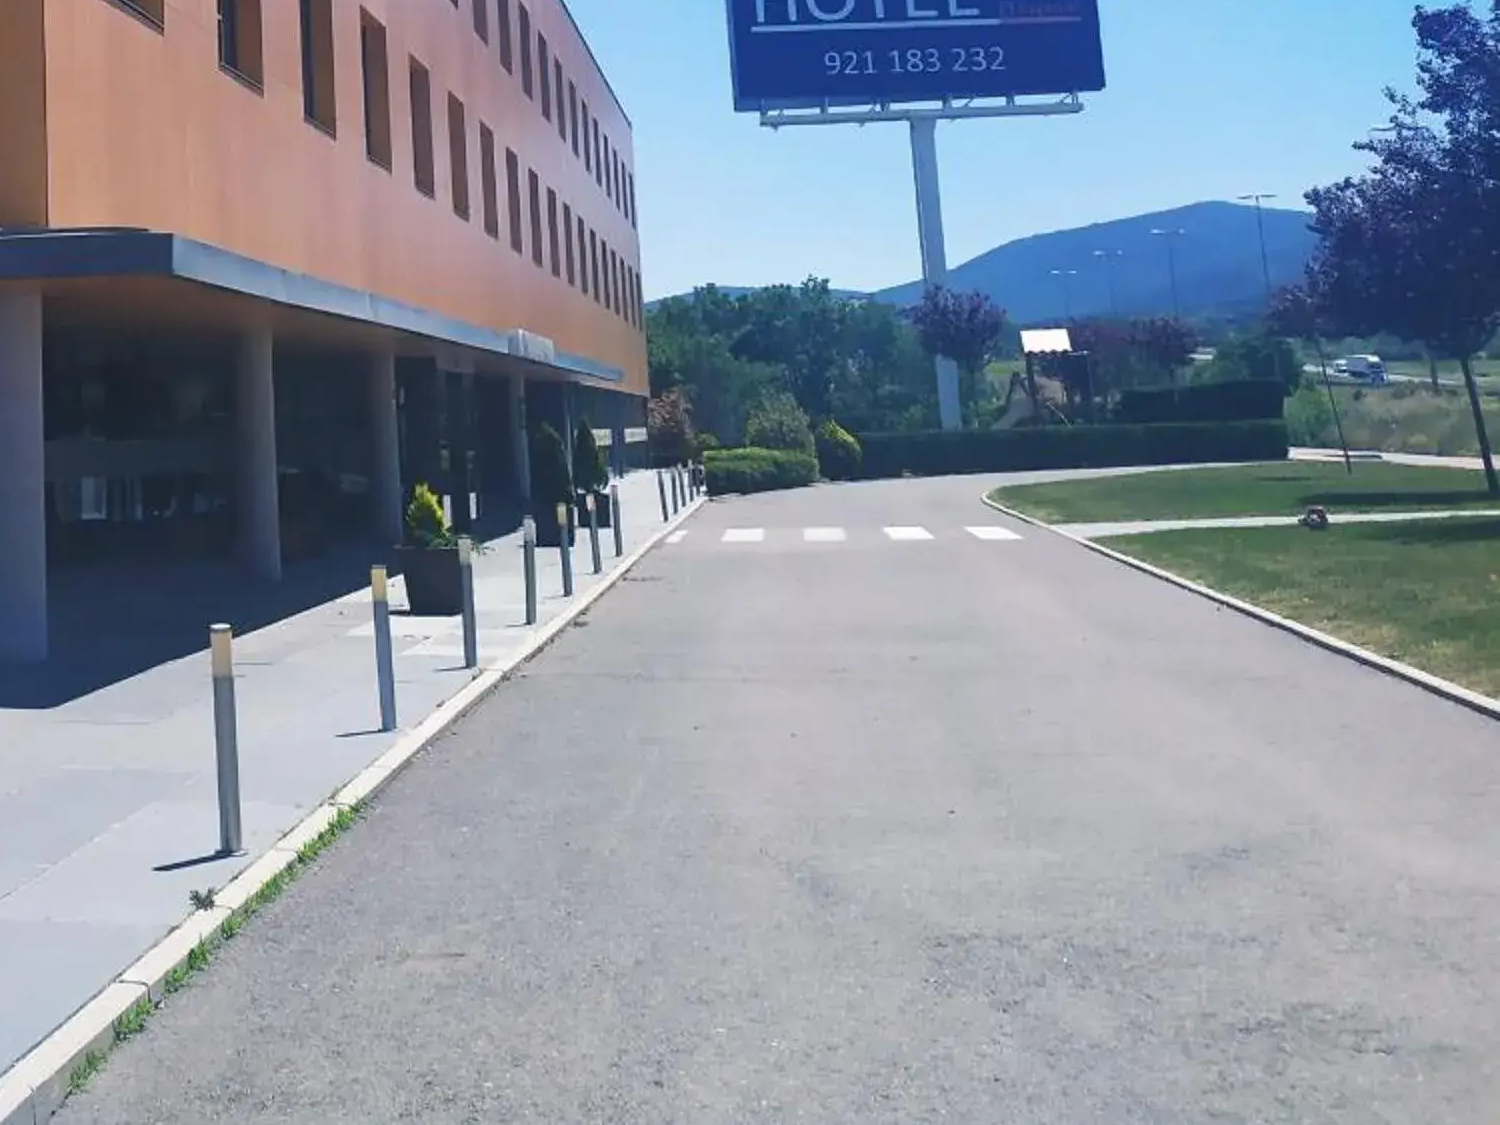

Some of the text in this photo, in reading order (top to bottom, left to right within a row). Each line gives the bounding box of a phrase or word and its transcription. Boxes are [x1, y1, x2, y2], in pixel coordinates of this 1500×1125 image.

[823, 46, 1006, 75] 921 183 232
